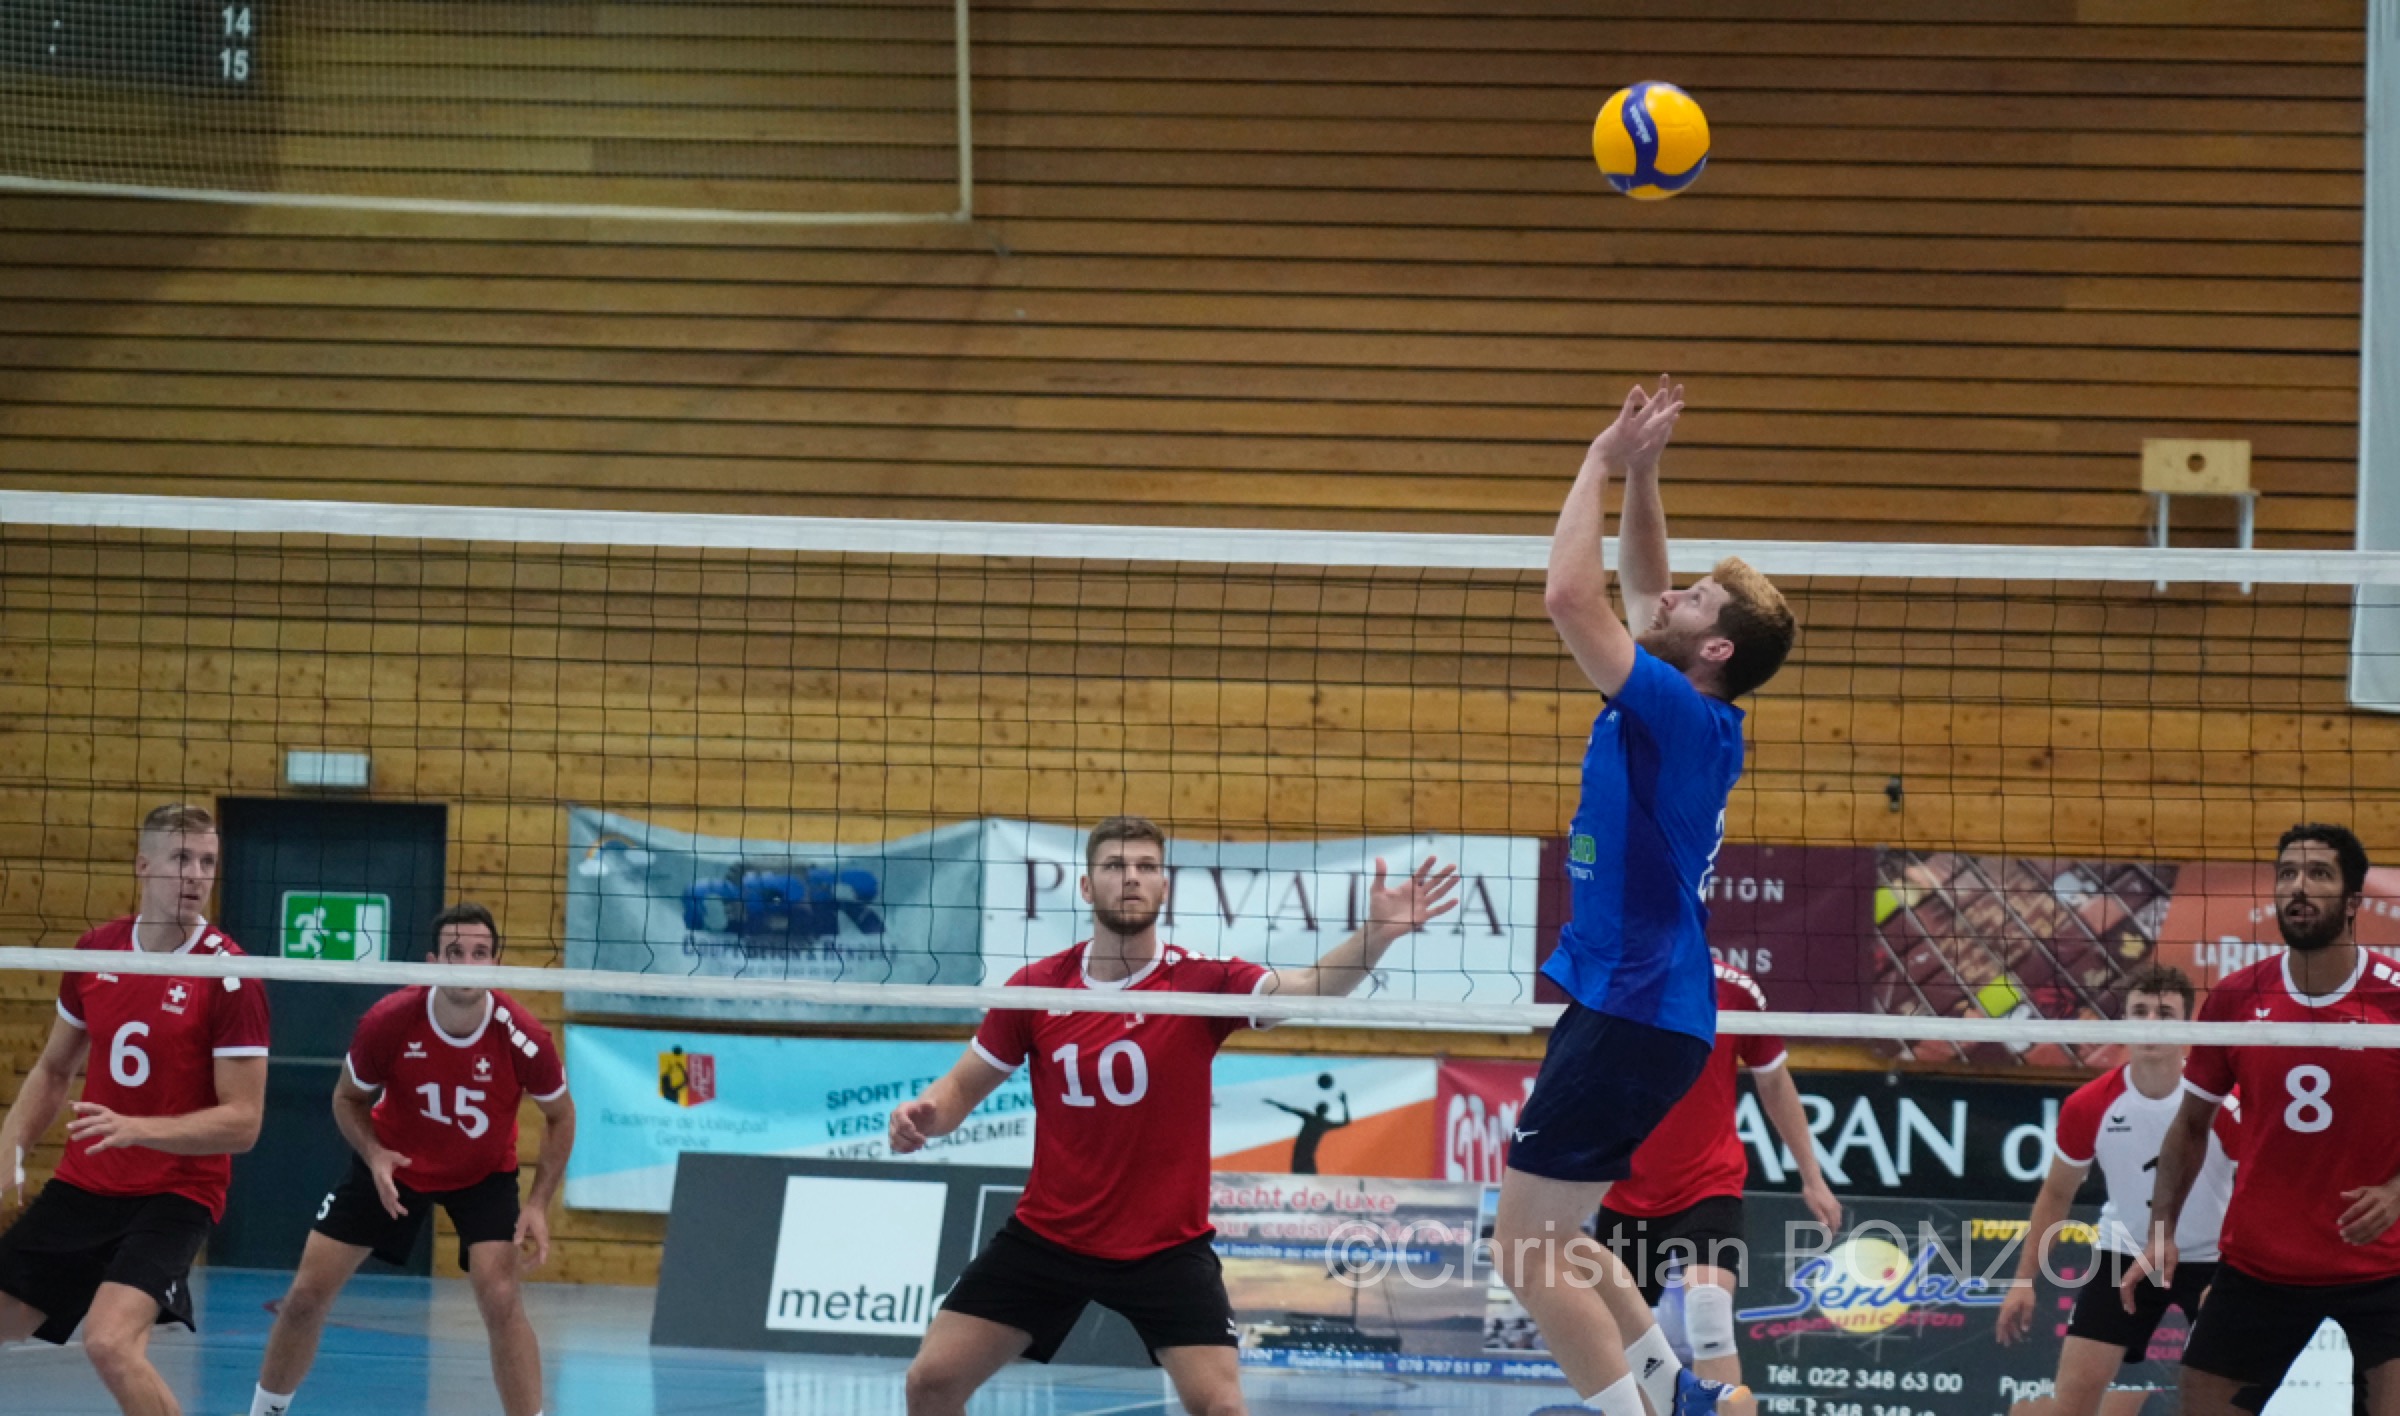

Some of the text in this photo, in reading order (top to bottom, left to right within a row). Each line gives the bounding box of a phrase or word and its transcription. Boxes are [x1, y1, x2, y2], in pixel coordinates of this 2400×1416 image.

[221, 5, 251, 38] 14
[219, 48, 250, 82] 15
[109, 1021, 150, 1088] 6
[1052, 1039, 1149, 1109] 10
[415, 1081, 490, 1139] 15
[826, 1081, 904, 1111] SPORT
[2283, 1063, 2334, 1134] 8
[826, 1111, 885, 1138] VERS
[1291, 1186, 1327, 1209] de
[1335, 1188, 1396, 1211] luxe
[1767, 1363, 1963, 1393] Tél. 022 348 63 00
